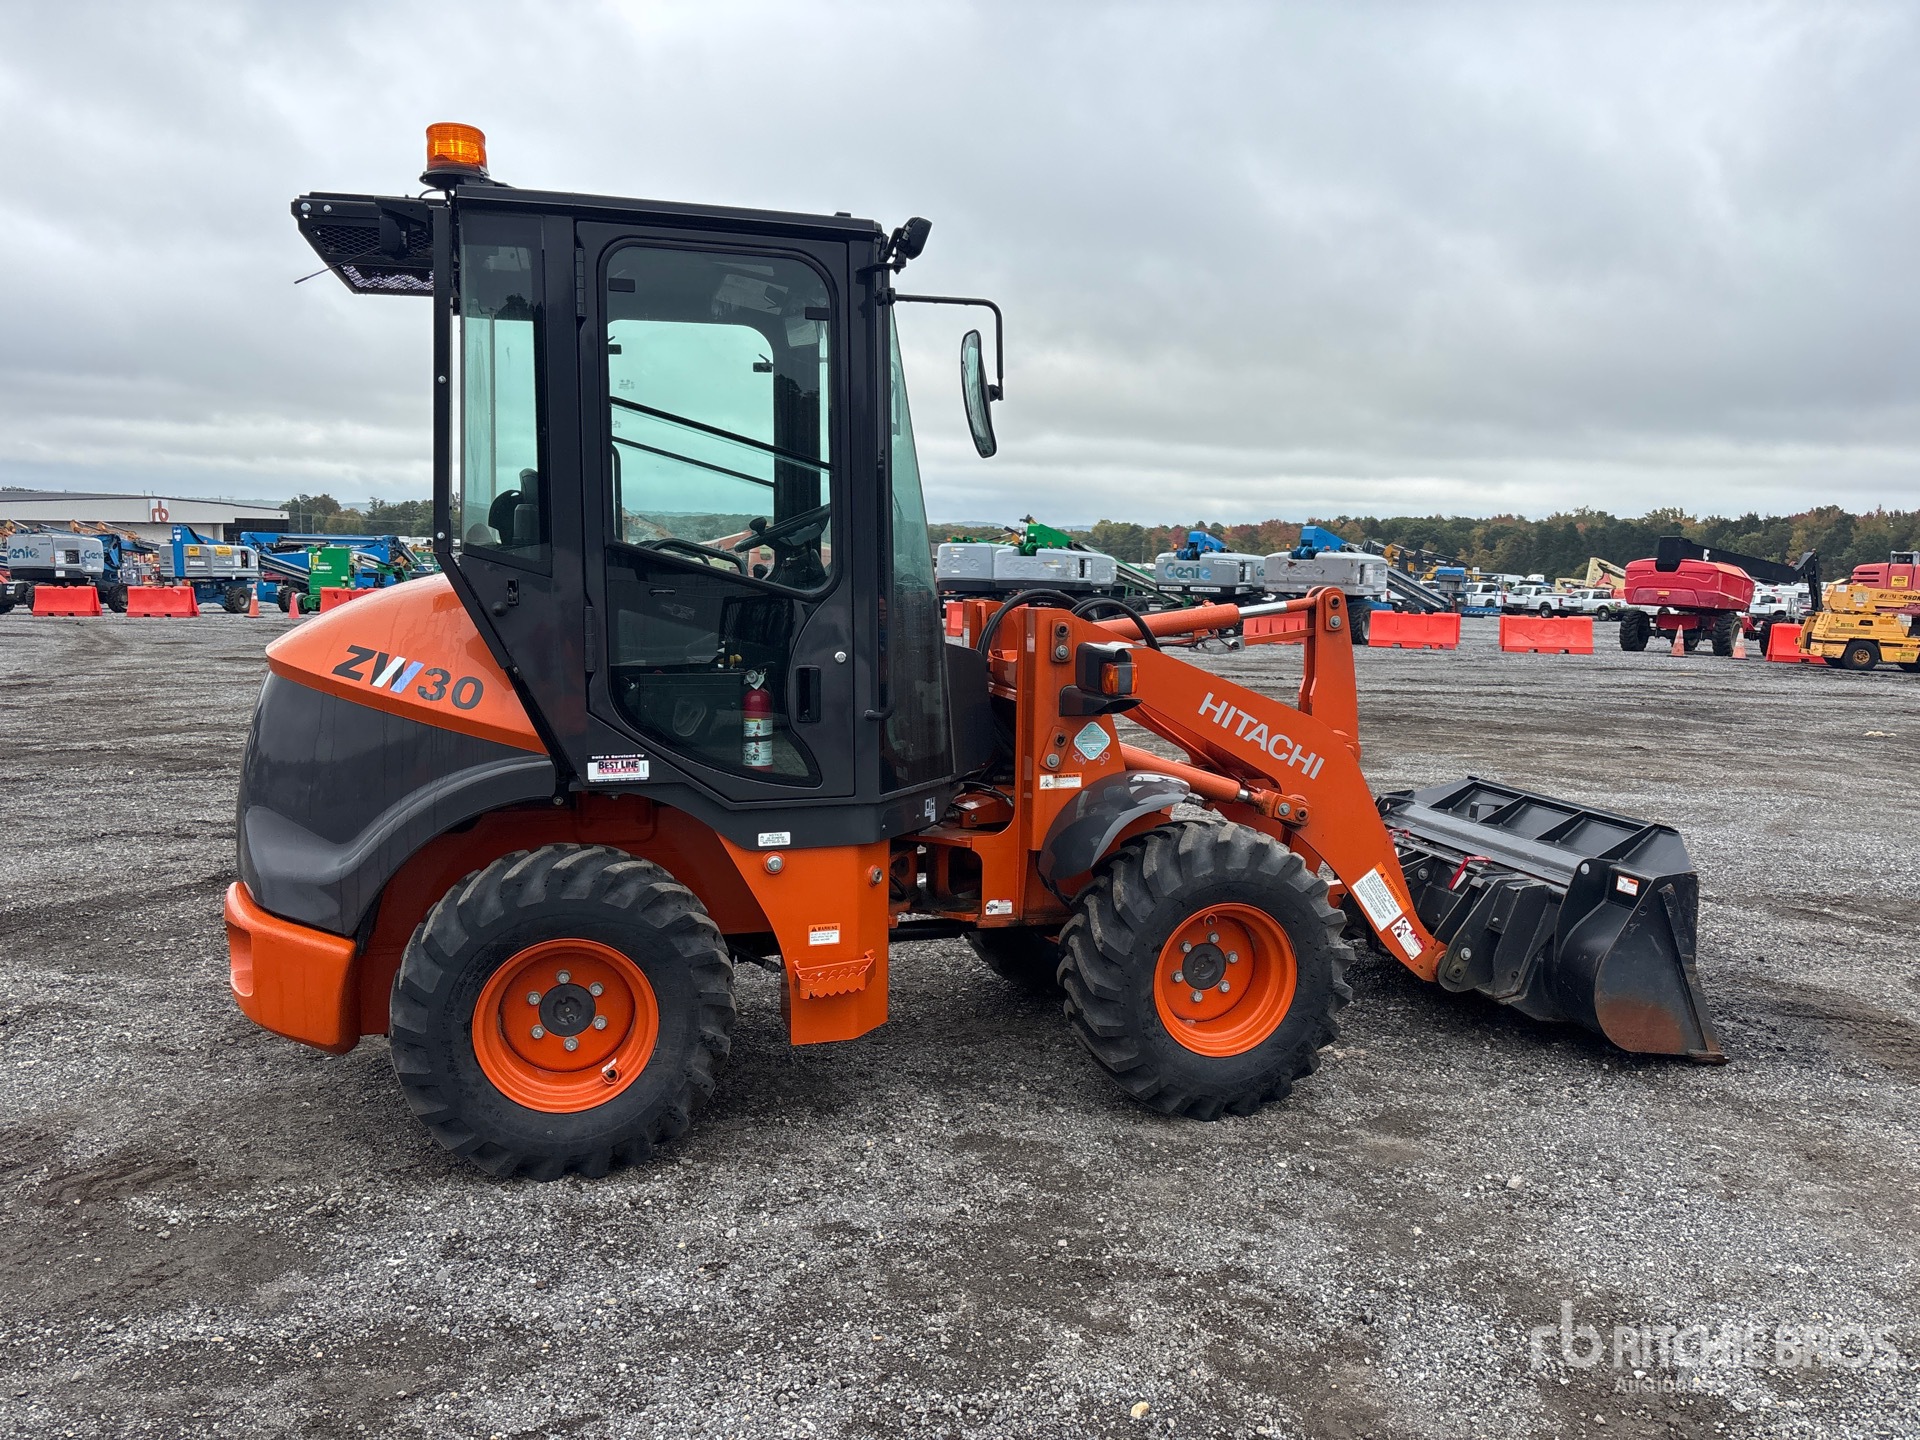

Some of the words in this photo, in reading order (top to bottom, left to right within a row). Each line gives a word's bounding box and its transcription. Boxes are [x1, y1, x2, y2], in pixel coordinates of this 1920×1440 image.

[152, 500, 169, 522] rb
[1164, 562, 1212, 580] Genie
[1198, 692, 1325, 780] HITACHI
[598, 761, 619, 770] BEST
[620, 760, 639, 769] LINE
